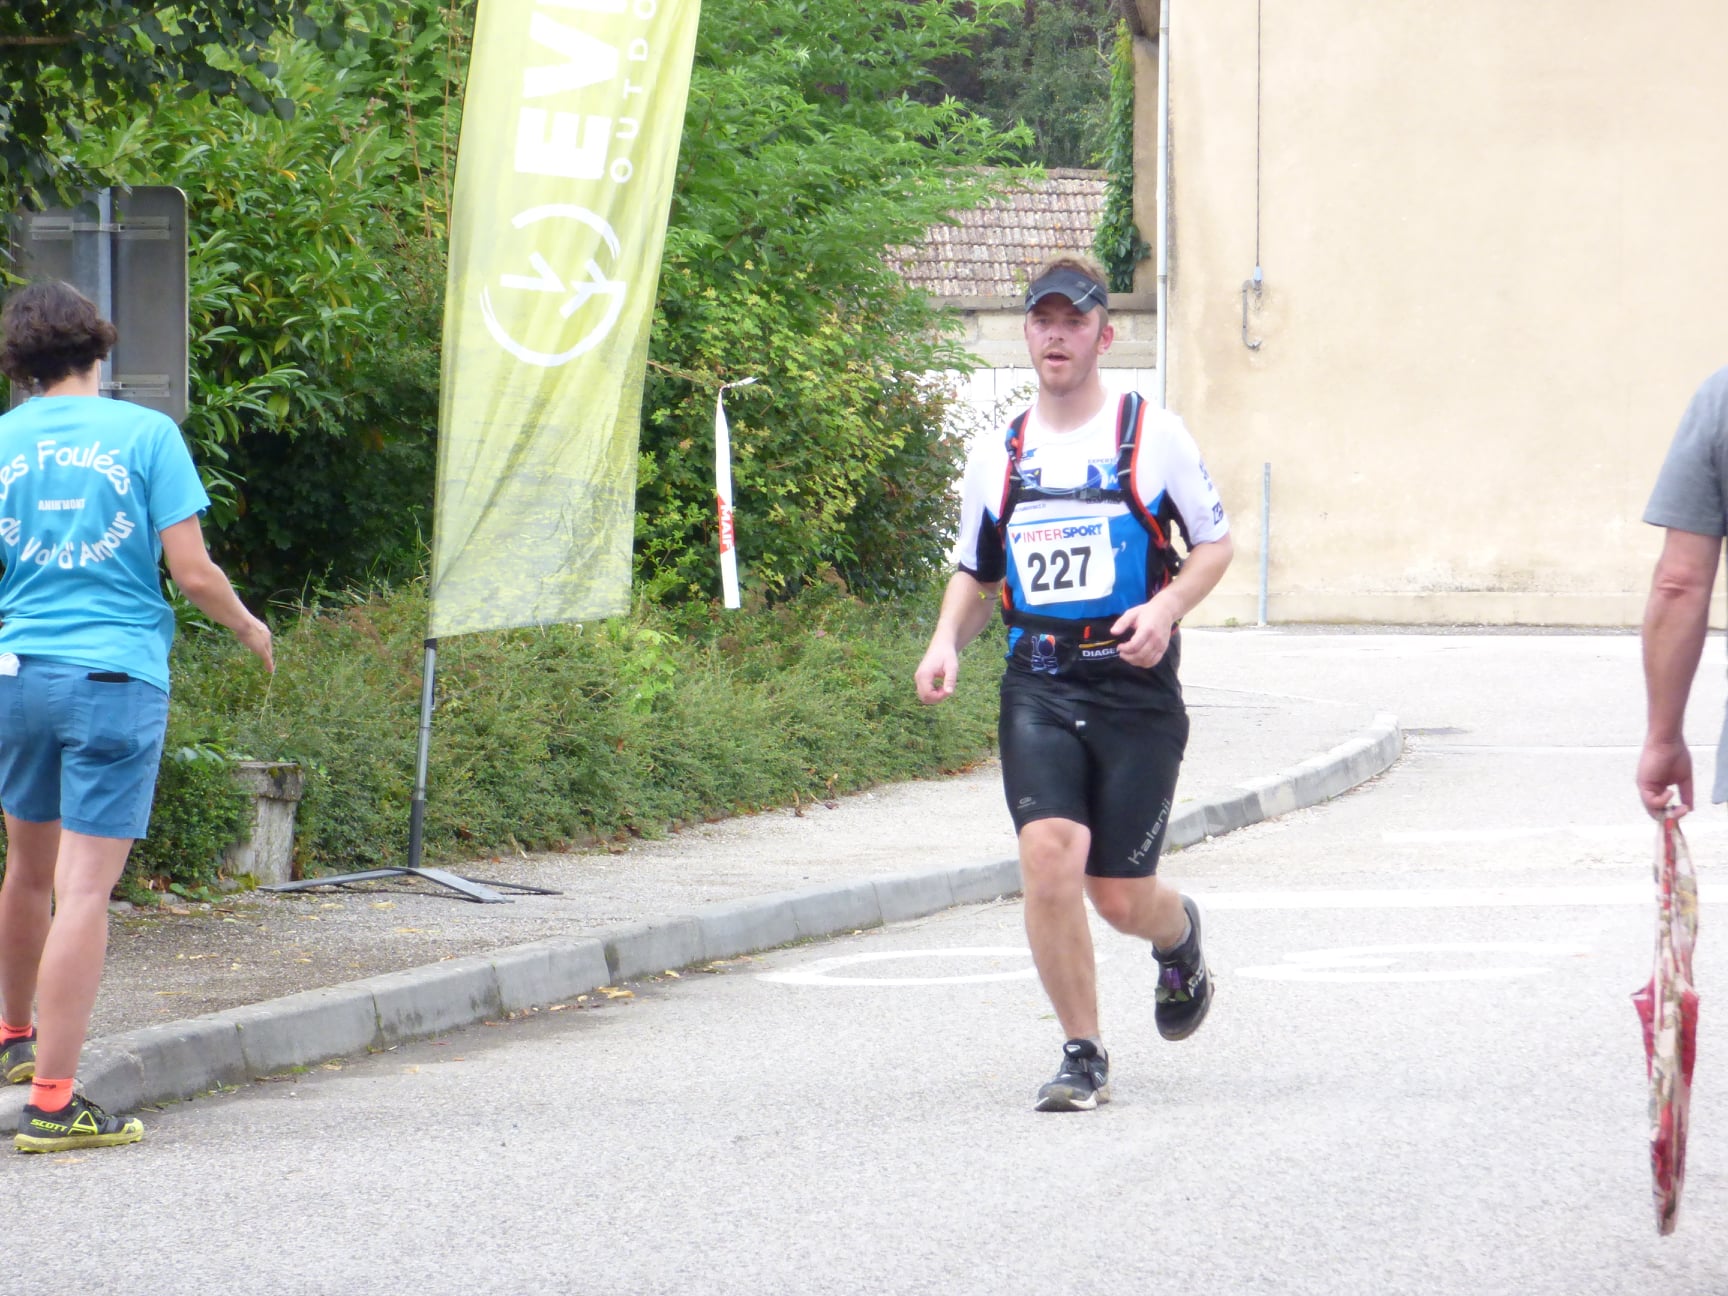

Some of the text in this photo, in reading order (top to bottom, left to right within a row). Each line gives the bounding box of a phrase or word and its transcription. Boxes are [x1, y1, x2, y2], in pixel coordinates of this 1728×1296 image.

[513, 0, 628, 180] EV
[37, 440, 130, 495] Foulées
[1023, 523, 1103, 543] INTERSPORT
[1027, 546, 1092, 592] 227
[30, 1118, 69, 1132] SCOTT
